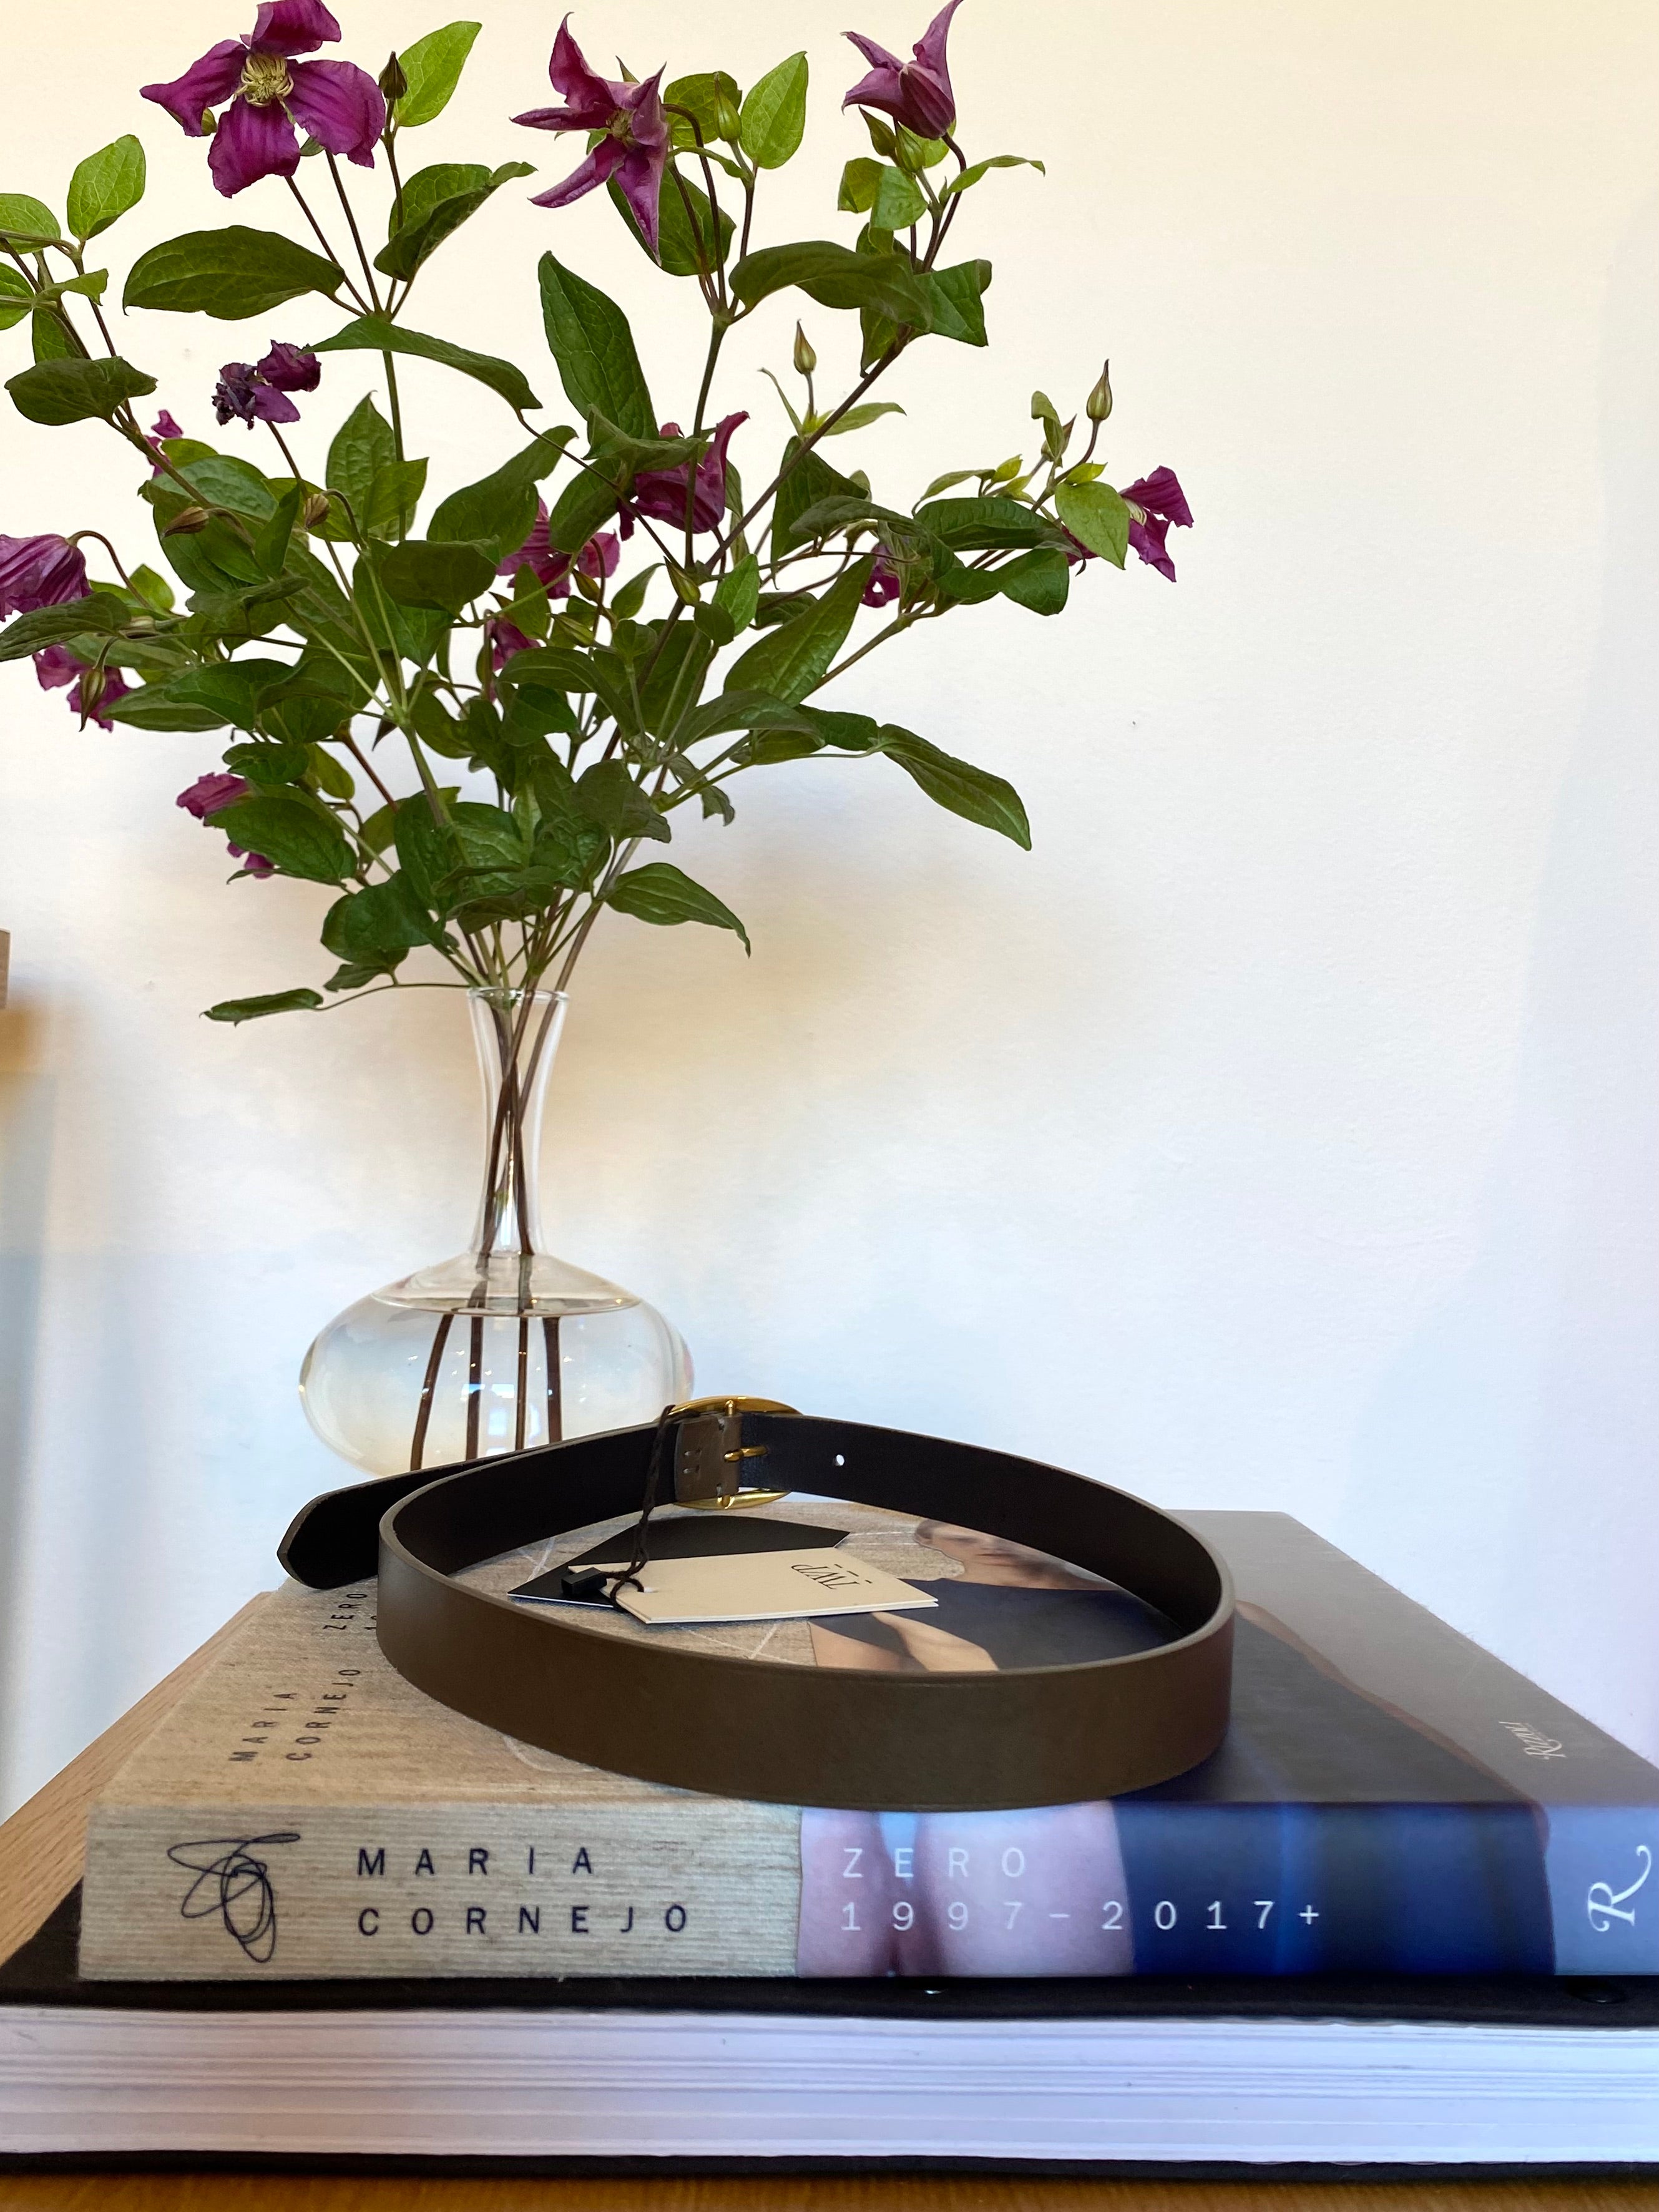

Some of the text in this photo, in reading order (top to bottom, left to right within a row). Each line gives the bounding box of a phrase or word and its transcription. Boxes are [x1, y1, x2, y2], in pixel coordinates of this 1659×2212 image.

[791, 1564, 859, 1590] TWP
[323, 1593, 368, 1630] ZERO
[228, 1693, 297, 1761] MARIA
[285, 1669, 361, 1761] CORNEJO
[356, 1847, 594, 1876] MARIA
[843, 1847, 1026, 1879] ZERO
[1587, 1845, 1652, 1932] R
[357, 1905, 688, 1936] CORNEJO
